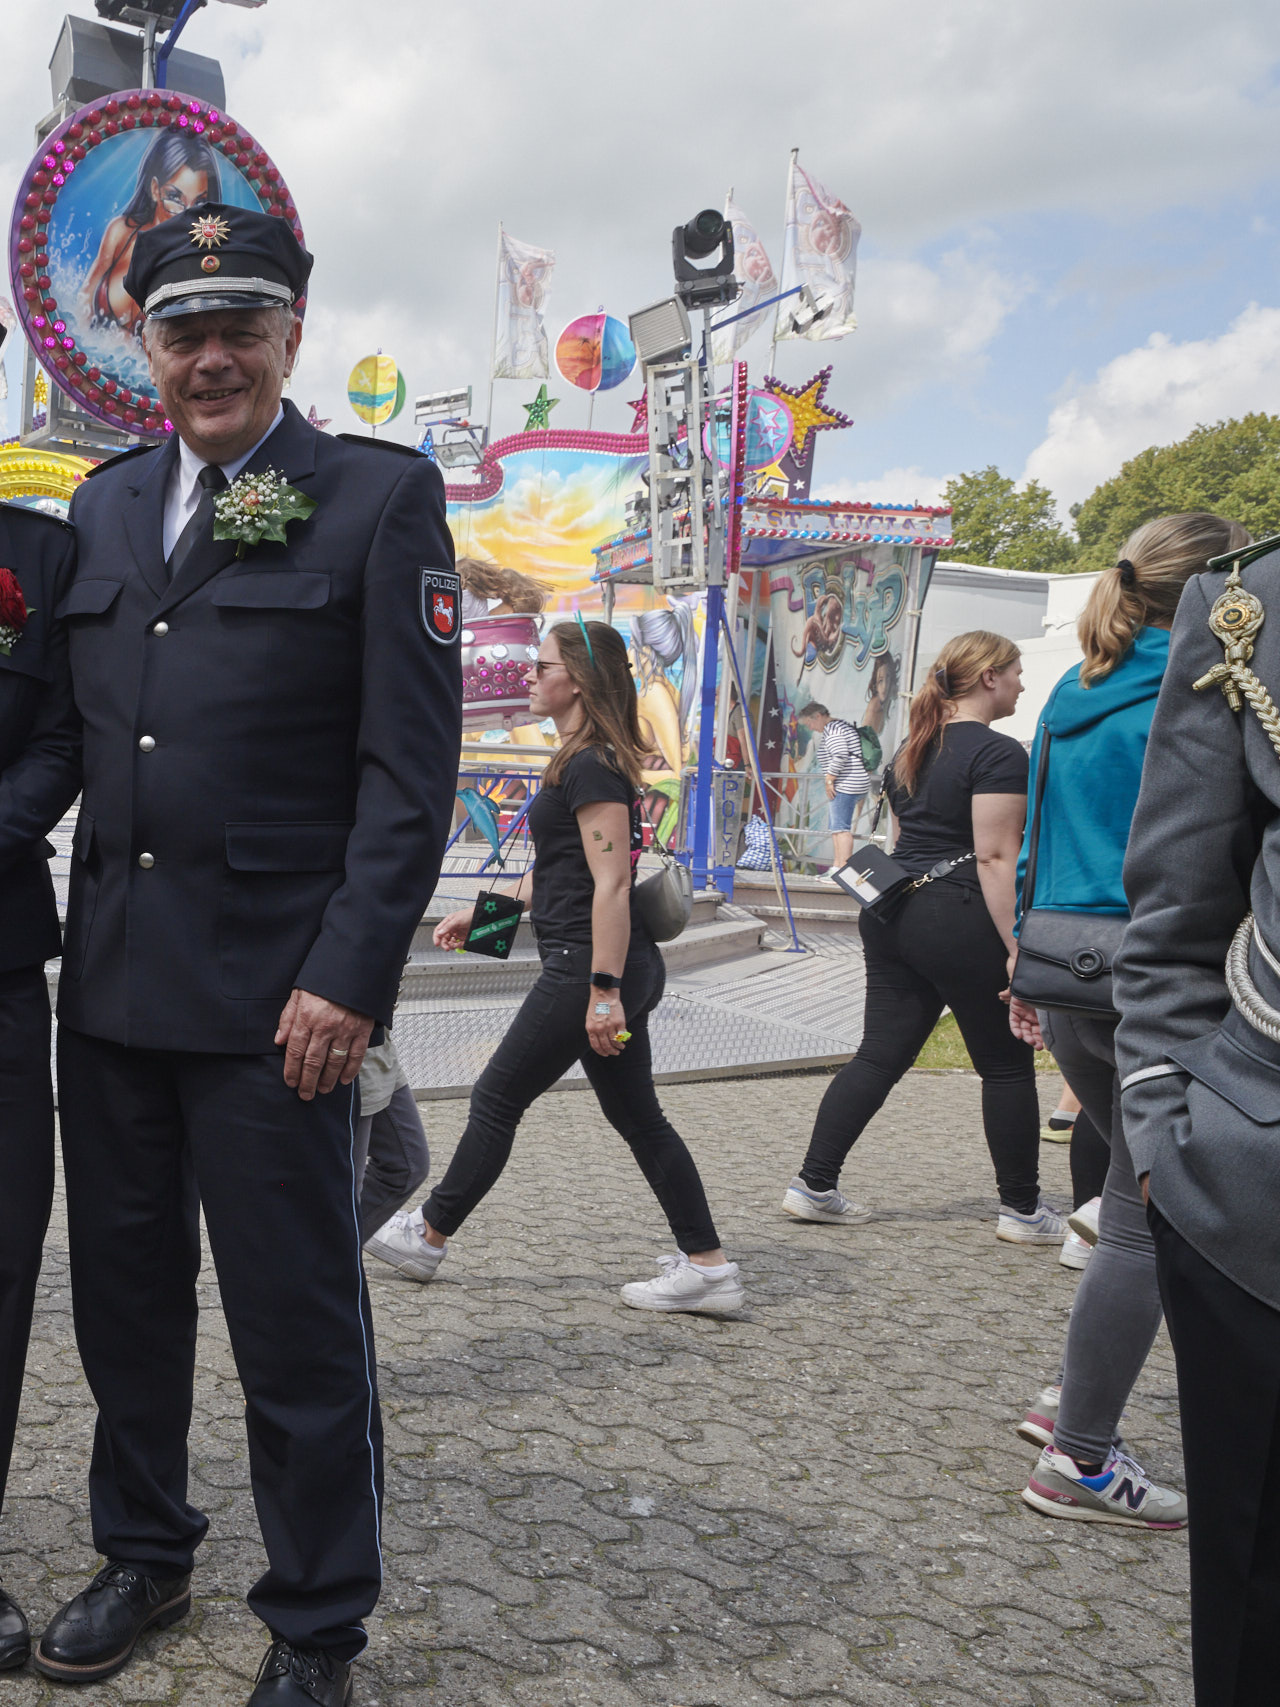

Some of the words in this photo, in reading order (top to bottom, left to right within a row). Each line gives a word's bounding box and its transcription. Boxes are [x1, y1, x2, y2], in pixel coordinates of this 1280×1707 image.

[767, 509, 811, 529] ST.
[827, 513, 919, 535] LUCIA
[722, 780, 738, 863] POLYP
[1111, 1477, 1148, 1512] N
